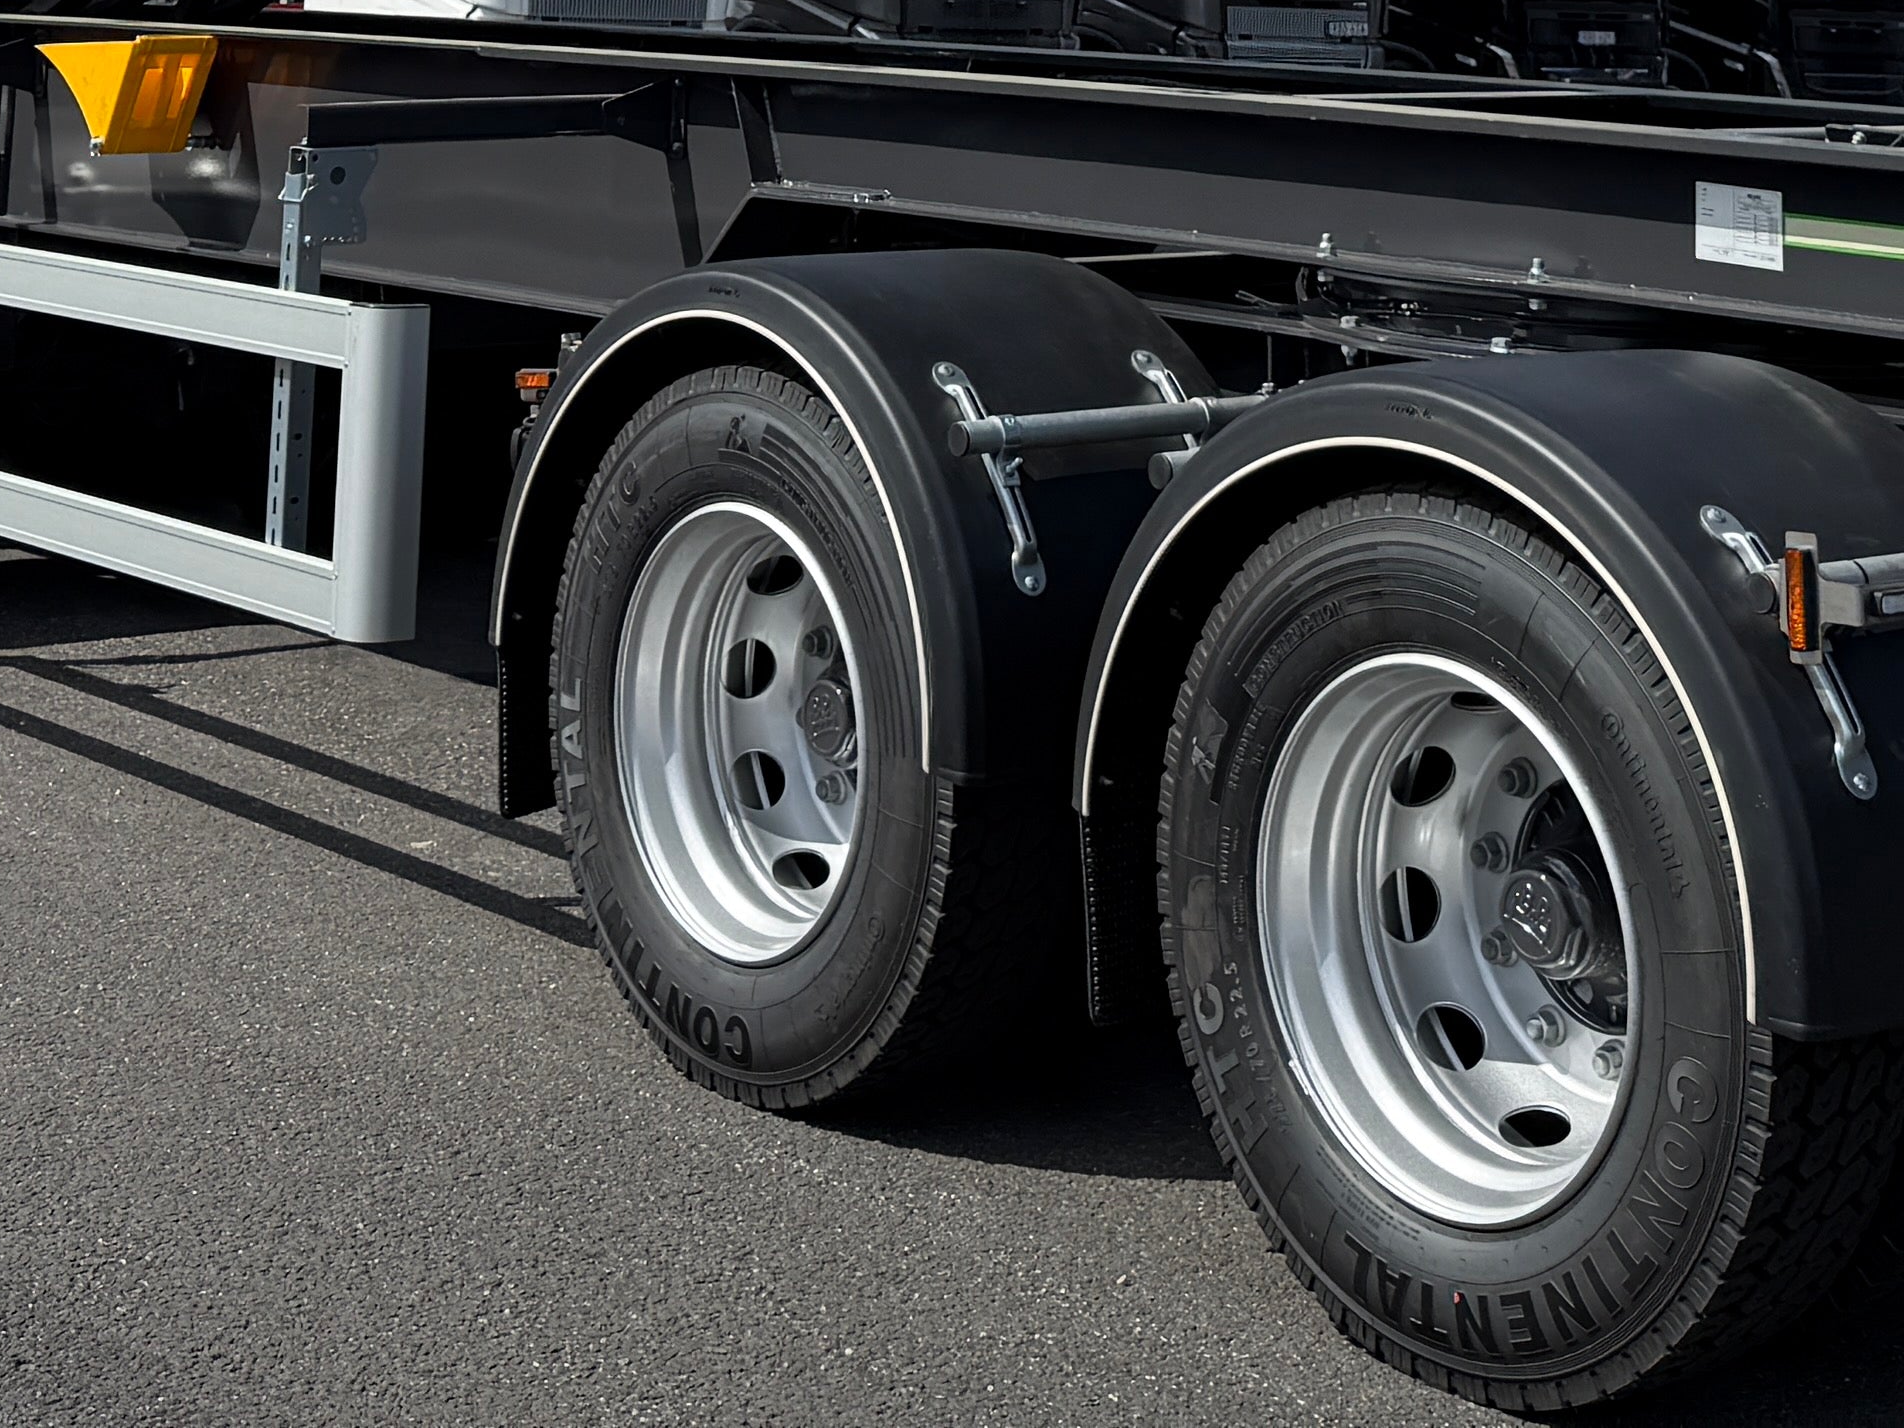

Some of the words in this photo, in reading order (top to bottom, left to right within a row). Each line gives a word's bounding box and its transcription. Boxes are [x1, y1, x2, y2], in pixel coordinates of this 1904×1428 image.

[560, 676, 753, 1065] CONTINENTAL
[1600, 706, 1685, 877] Continental
[1192, 981, 1270, 1155] HTC
[1344, 1055, 1719, 1356] CONTINENTAL
